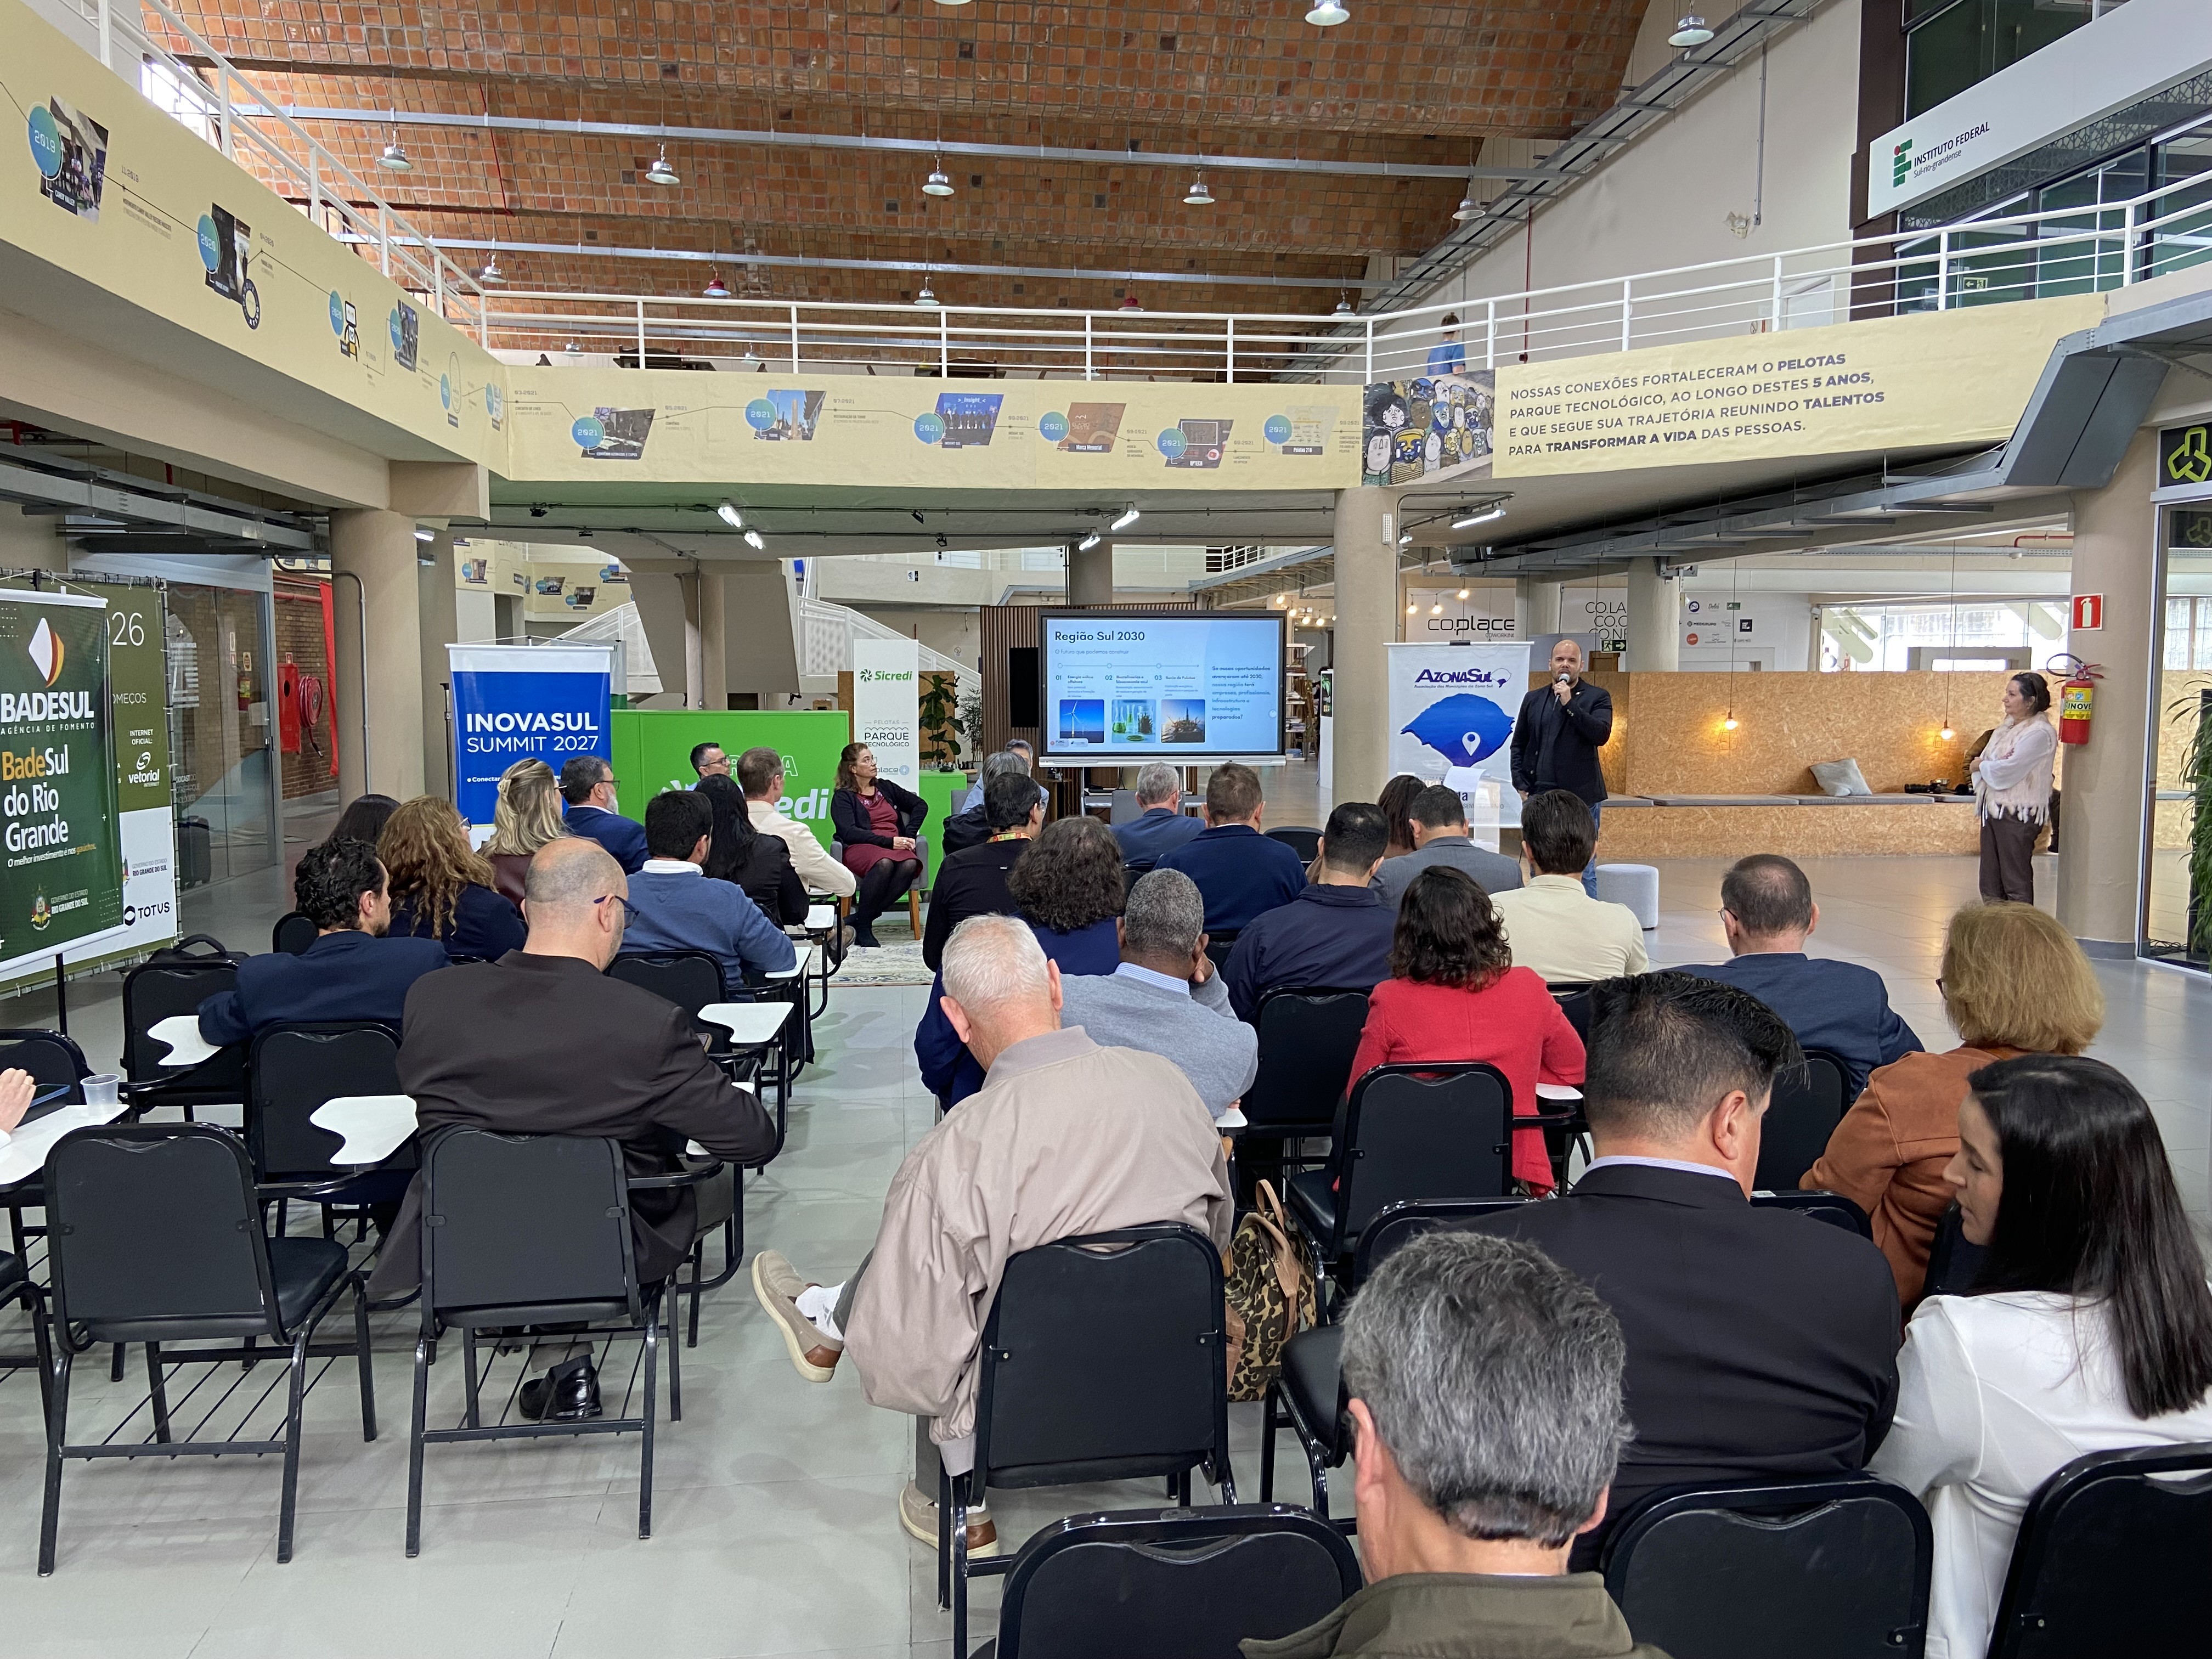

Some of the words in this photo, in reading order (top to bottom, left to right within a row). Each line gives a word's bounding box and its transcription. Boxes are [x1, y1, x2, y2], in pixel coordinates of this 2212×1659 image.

[35, 129, 55, 153] 2019
[1914, 140, 1953, 167] INSTITUTO
[1956, 122, 1989, 146] FEDERAL
[1914, 150, 1961, 178] Sul-rio-grandense
[201, 234, 216, 251] 2020
[1511, 386, 1560, 400] NOSSAS
[1565, 377, 1638, 394] CONEXÕES
[1643, 364, 1757, 386] FORTALECERAM
[1763, 362, 1773, 373] O
[1778, 354, 1846, 371] PELOTAS
[1510, 405, 1560, 419] PARQUE
[1565, 393, 1666, 413] TECNOLÓGICO,
[1671, 391, 1691, 403] AO
[1696, 386, 1747, 400] LONGO
[1753, 379, 1808, 394] DESTES
[1813, 377, 1821, 388] 5
[1825, 372, 1874, 387] ANOS,
[1510, 428, 1516, 437] E
[1521, 425, 1546, 437] QUE
[1551, 420, 1593, 433] SEGUE
[1598, 417, 1623, 429] SUA
[1628, 408, 1715, 426] TRAJETÓRIA
[1720, 400, 1798, 417] REUNINDO
[1803, 392, 1884, 409] TALENTOS
[1509, 444, 1541, 455] PARA
[1546, 435, 1646, 453] TRANSFORMAR
[1649, 433, 1660, 443] A
[1663, 430, 1697, 442] VIDA
[1702, 427, 1729, 439] DAS
[1735, 420, 1805, 437] PESSOAS.
[106, 612, 144, 646] 26
[1055, 631, 1093, 643] Região
[1097, 631, 1114, 640] Sul
[1117, 631, 1145, 641] 2030
[874, 670, 912, 680] Sicredi
[1, 691, 94, 723] BADESUL
[1, 725, 40, 735] AGÊNCIA
[60, 722, 94, 731] FOMENTO
[467, 713, 598, 732] INOVASUL
[467, 737, 547, 753] SUMMIT
[554, 735, 598, 751] 2027
[2, 744, 69, 780] BadeSul
[128, 769, 160, 783] vetorial
[4, 785, 29, 817] do
[32, 782, 59, 812] Rio
[5, 814, 68, 852] Grande
[8, 859, 13, 867] O
[14, 855, 33, 866] melhor
[33, 851, 64, 862] investimento
[59, 901, 75, 912] GRANDE
